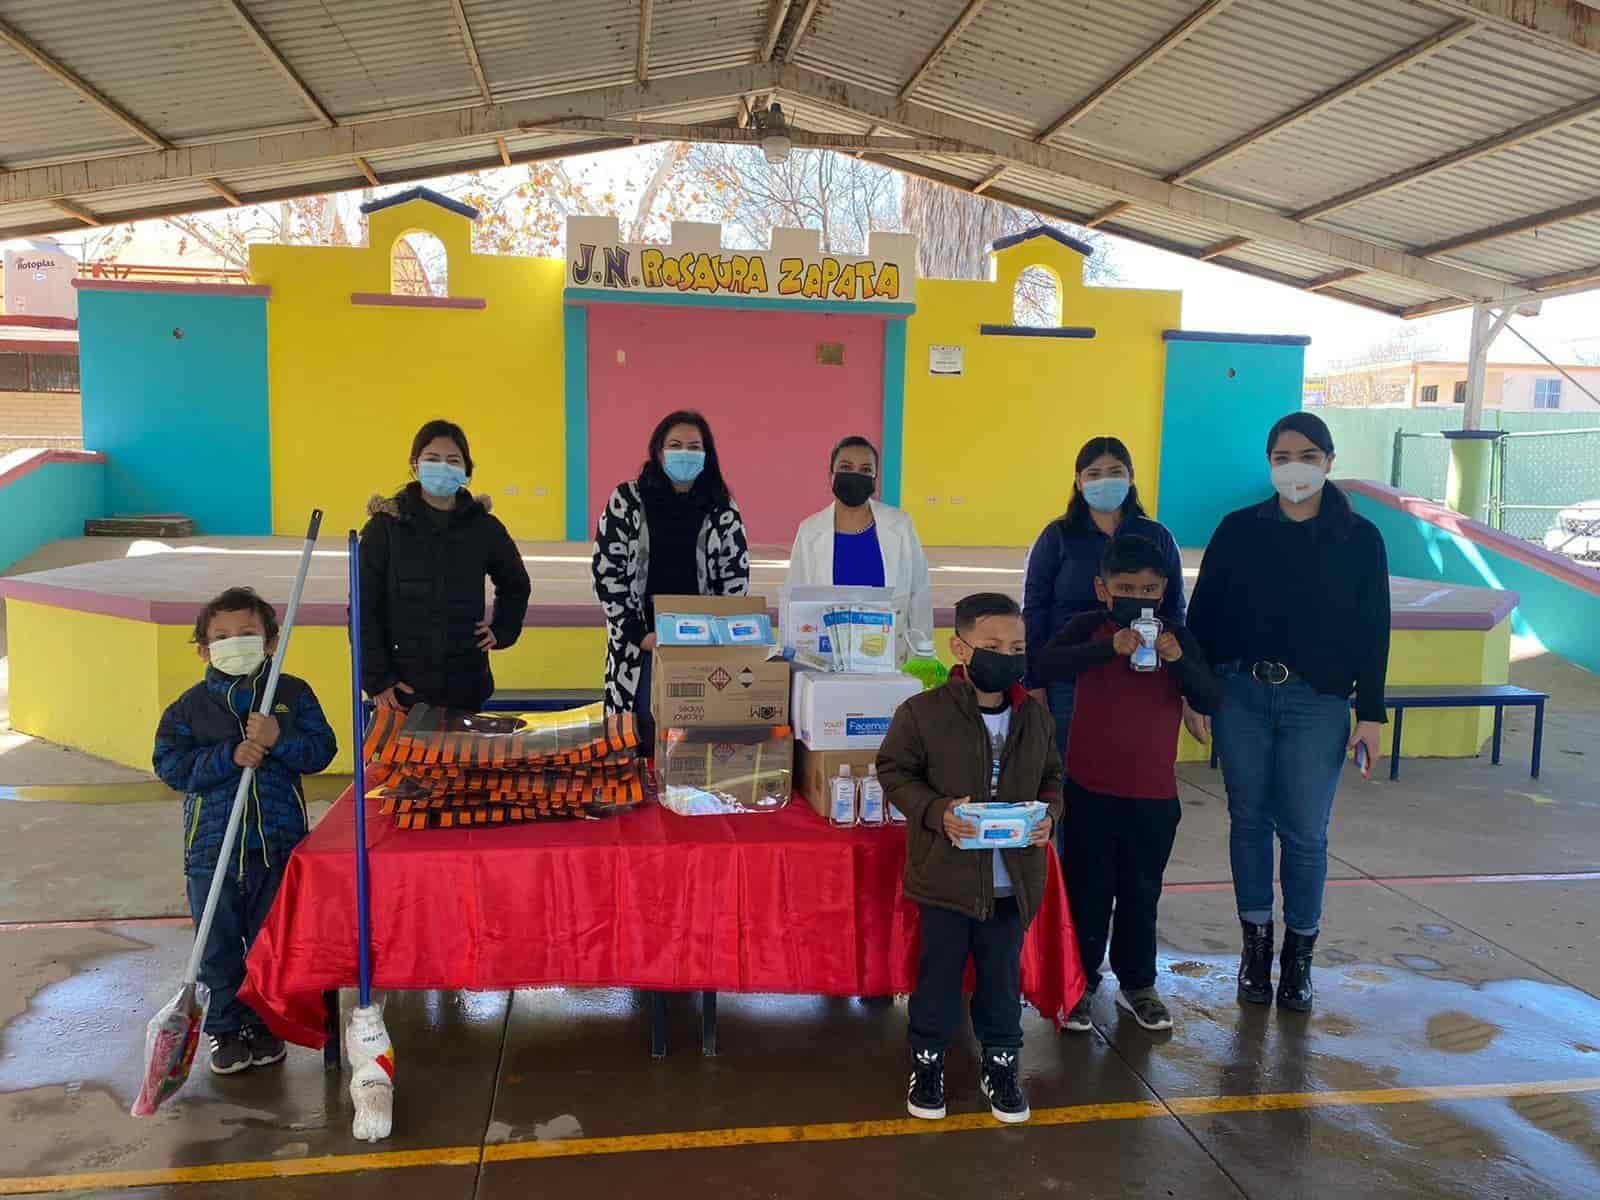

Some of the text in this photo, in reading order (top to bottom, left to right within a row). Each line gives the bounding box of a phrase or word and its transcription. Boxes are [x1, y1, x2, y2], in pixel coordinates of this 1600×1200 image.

[573, 243, 900, 300] J.N. ROSAURA ZAPATA
[849, 720, 890, 730] Facemas
